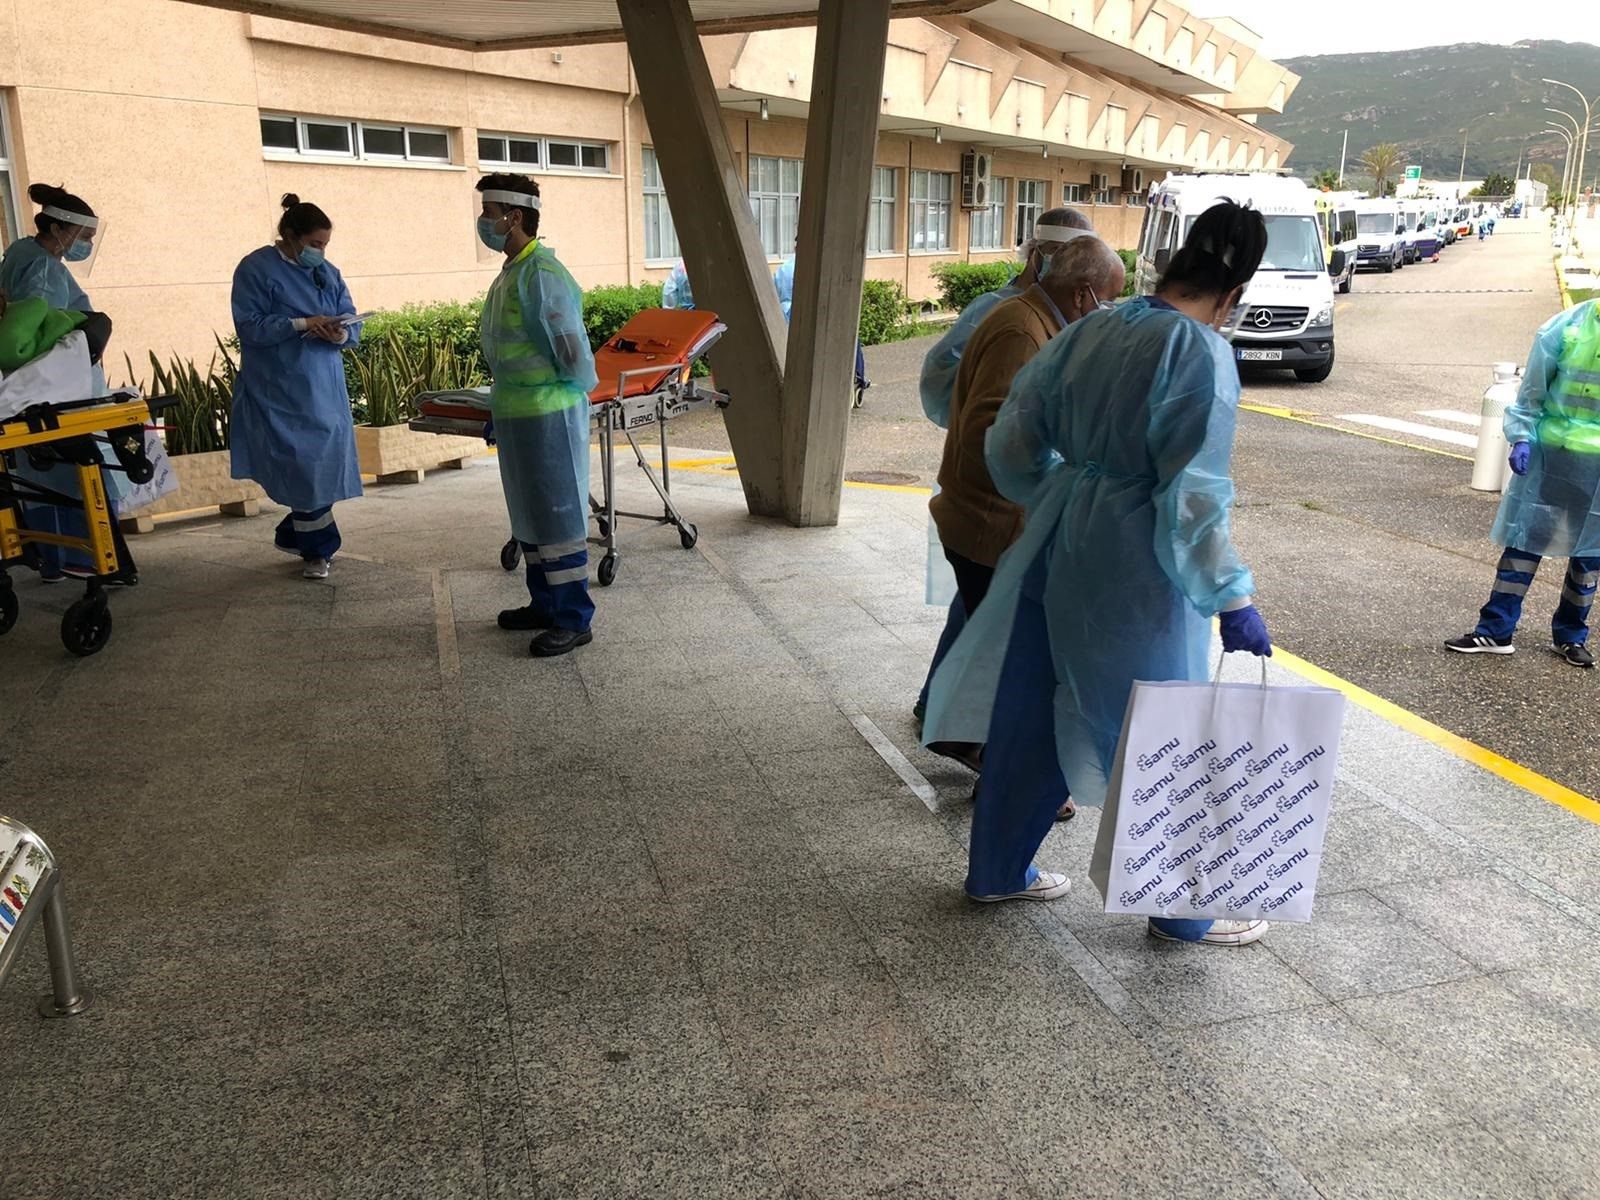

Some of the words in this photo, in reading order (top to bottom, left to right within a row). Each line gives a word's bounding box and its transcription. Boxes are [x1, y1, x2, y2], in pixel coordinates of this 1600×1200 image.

[1243, 352, 1262, 360] 2892
[1266, 352, 1280, 360] KBN
[630, 413, 653, 426] FERNO
[1144, 737, 1180, 768] samu
[1180, 739, 1216, 770] samu
[1217, 741, 1254, 772] samu
[1254, 743, 1289, 774] samu
[1289, 745, 1325, 775] samu
[1140, 772, 1175, 802] samu
[1175, 774, 1211, 804] samu
[1212, 776, 1248, 806] samu
[1250, 779, 1284, 809] samu
[1284, 780, 1319, 810] samu
[1136, 806, 1170, 836] samu
[1171, 808, 1207, 837] samu
[1208, 811, 1244, 840] samu
[1245, 813, 1279, 843] samu
[1280, 814, 1314, 844] samu
[1131, 840, 1166, 872] samu
[1166, 842, 1202, 873] samu
[1204, 846, 1239, 876] samu
[1240, 848, 1274, 877] samu
[1274, 848, 1308, 877] samu
[1128, 874, 1162, 904] samu
[1164, 876, 1198, 905] samu
[1198, 880, 1234, 907] samu
[1234, 880, 1269, 910] samu
[1270, 881, 1303, 910] samu
